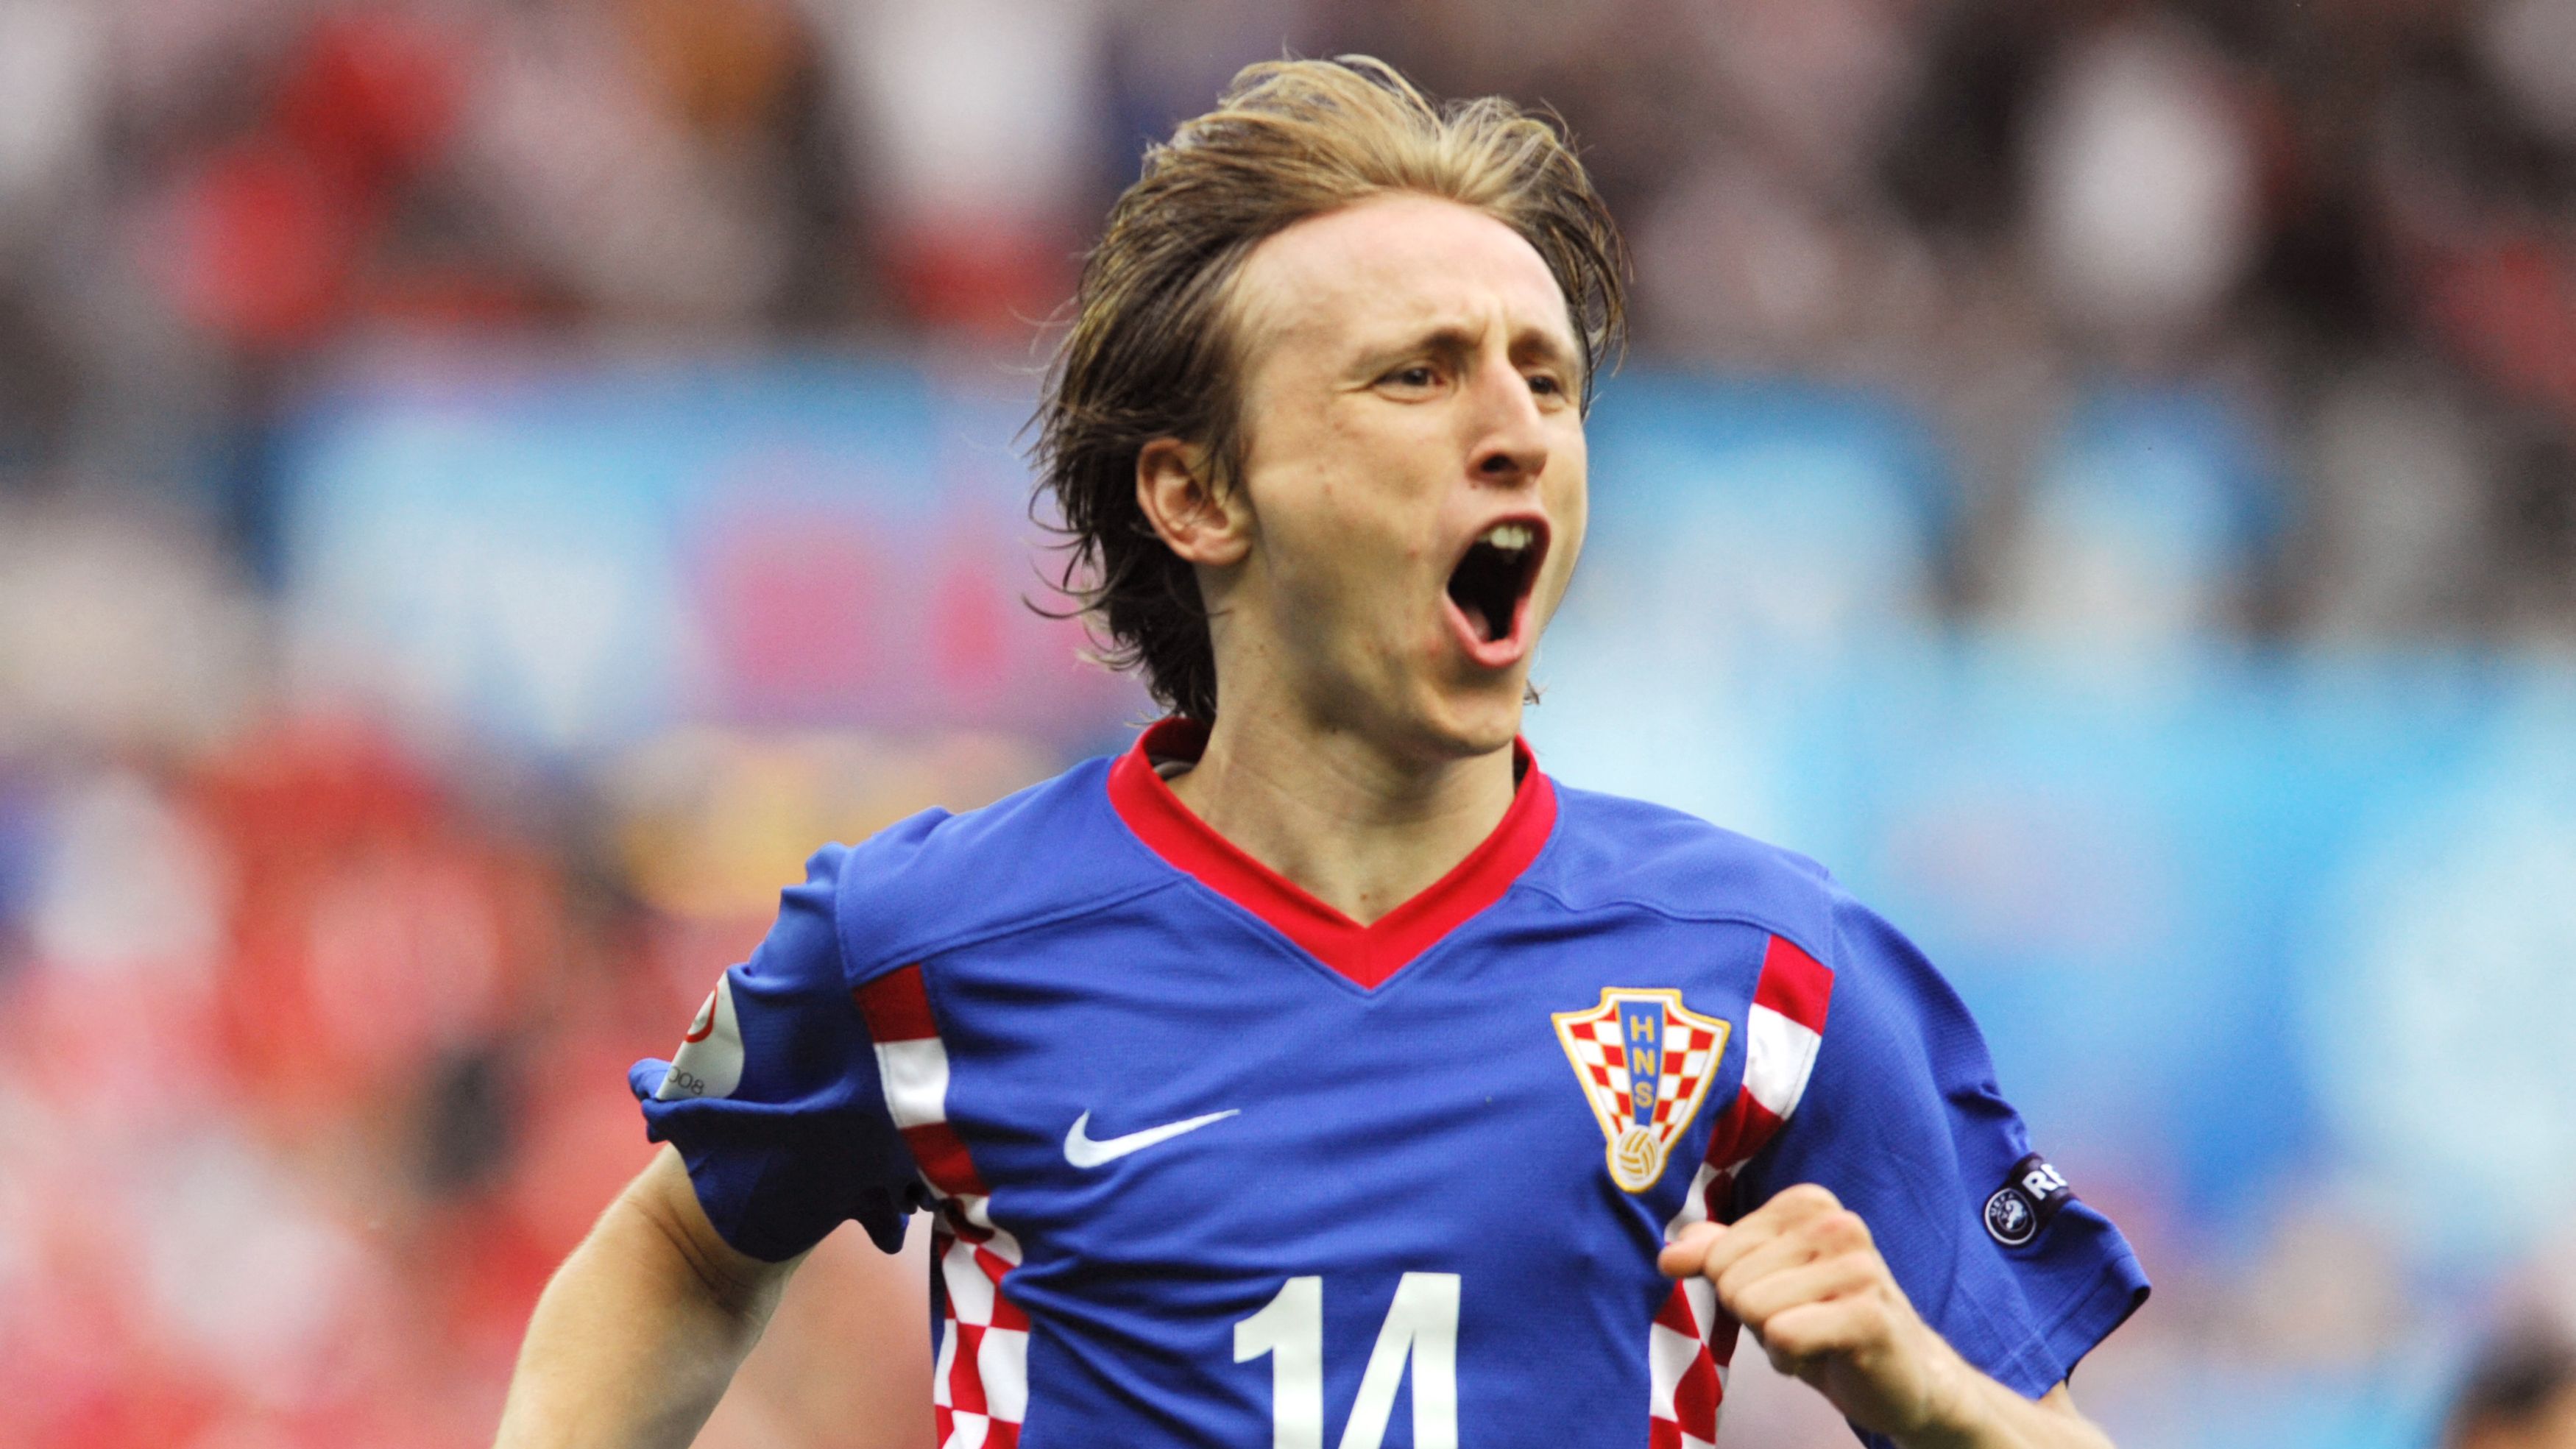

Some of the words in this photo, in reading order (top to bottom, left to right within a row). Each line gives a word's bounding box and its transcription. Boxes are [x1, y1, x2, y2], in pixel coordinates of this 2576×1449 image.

[1630, 1015, 1655, 1108] HNS
[1989, 1193, 2014, 1216] UEFA
[1234, 1271, 1462, 1449] 14
